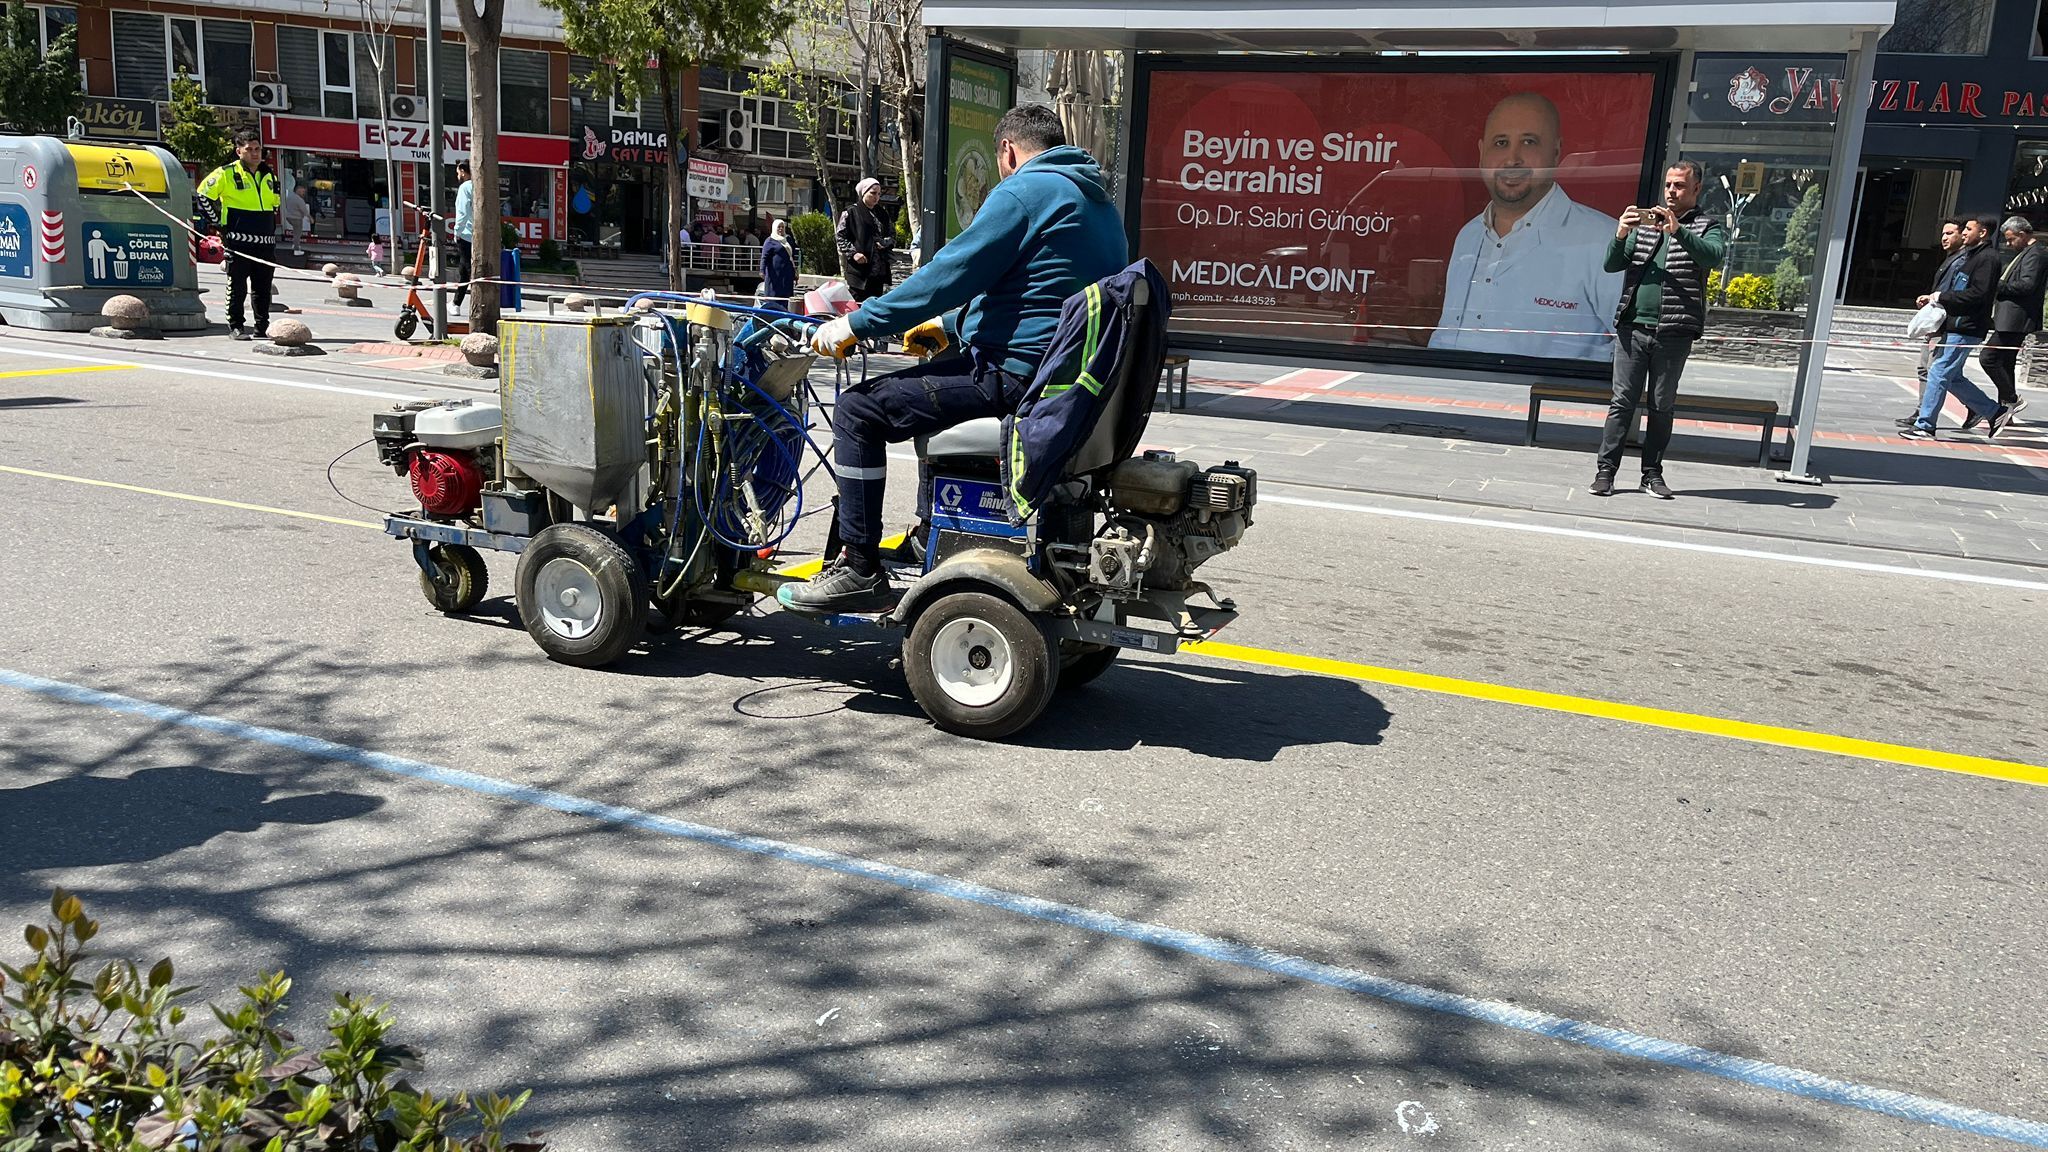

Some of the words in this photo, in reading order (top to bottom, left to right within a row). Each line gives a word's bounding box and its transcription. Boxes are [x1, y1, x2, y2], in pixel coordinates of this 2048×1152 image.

[1769, 67, 1987, 117] YAVZLAR
[611, 129, 667, 148] DAMLA
[1183, 130, 1270, 164] Beyin
[1276, 138, 1314, 160] ve
[1321, 132, 1397, 162] Sinir
[611, 147, 640, 162] ÇAY
[1180, 163, 1323, 195] Cerrahisi
[1177, 203, 1212, 229] Op.
[1216, 204, 1243, 227] Dr.
[1248, 206, 1303, 229] Sabri
[1309, 208, 1395, 236] Güngör
[0, 234, 20, 250] MAN
[129, 239, 168, 249] ÇÖPLER
[129, 252, 169, 260] BURAYA
[1172, 260, 1375, 293] MEDICALPOINT
[1171, 291, 1224, 303] mph.com.tr
[1232, 295, 1276, 306] 4443525
[1534, 297, 1579, 310] MEDICALPOINT
